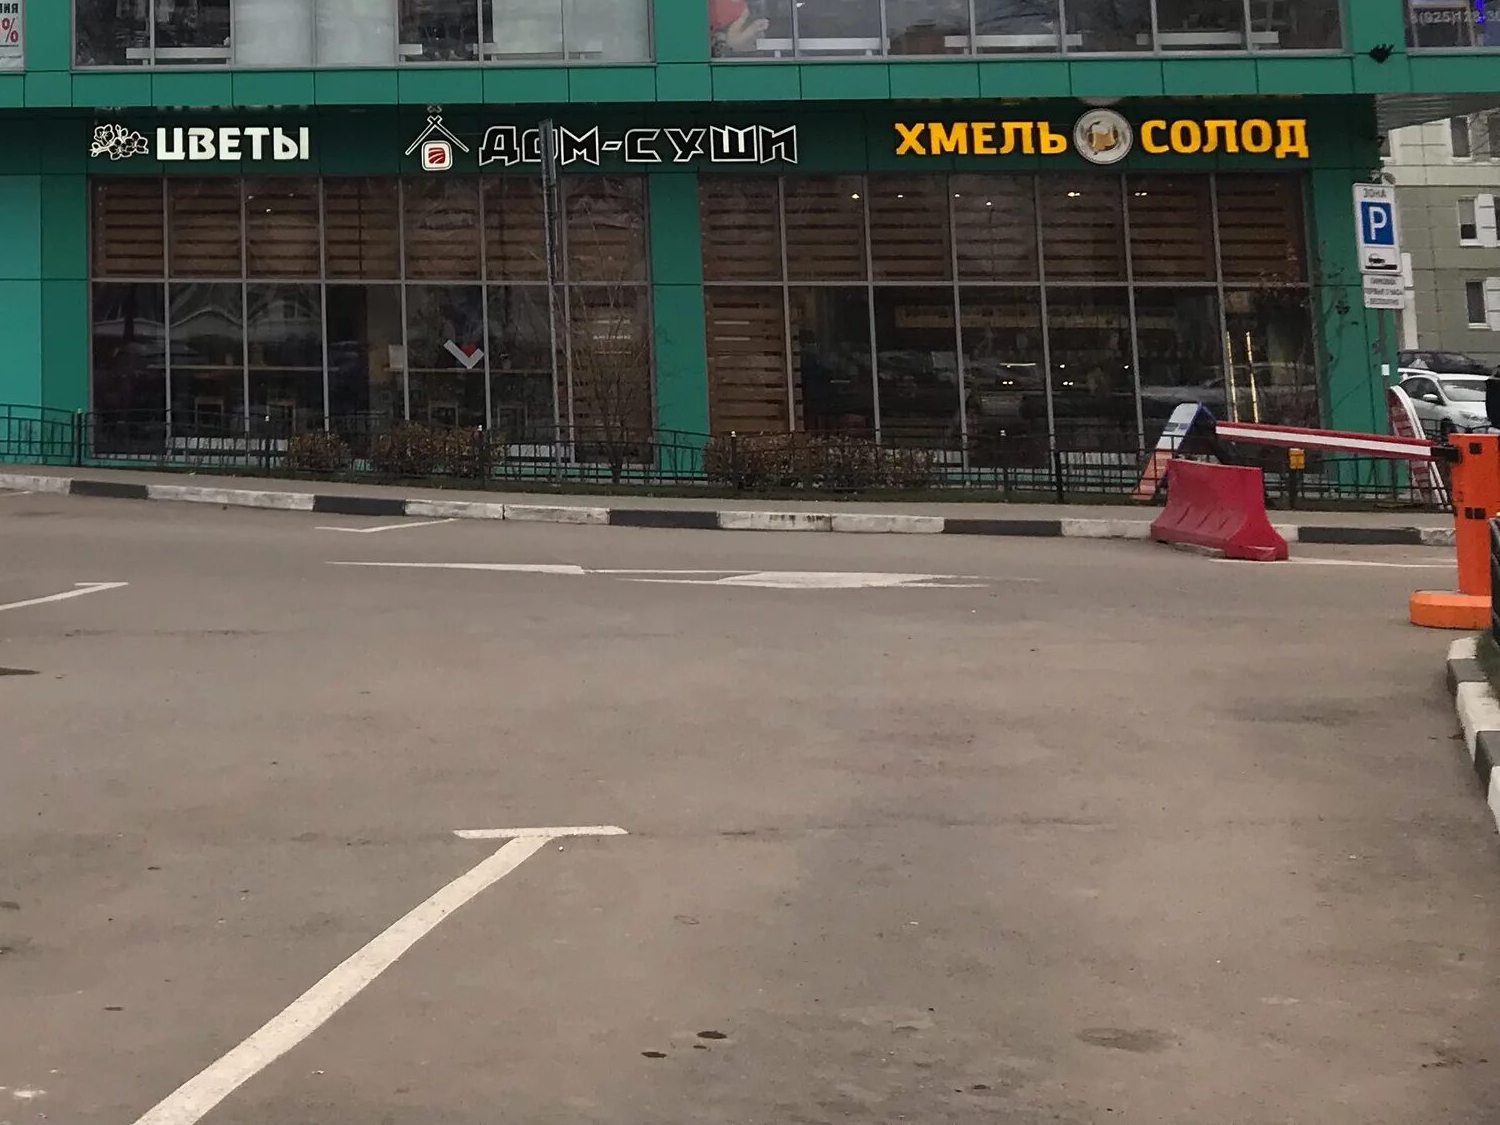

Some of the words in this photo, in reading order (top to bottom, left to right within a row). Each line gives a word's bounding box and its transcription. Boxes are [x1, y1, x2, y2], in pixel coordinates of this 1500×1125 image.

[156, 126, 309, 160] ЦВЕТЫ
[479, 125, 798, 166] ДОМ-СУШИ
[894, 120, 1068, 156] ХМЕЛЬ
[1140, 118, 1310, 159] СОЛОД
[1368, 206, 1387, 241] P
